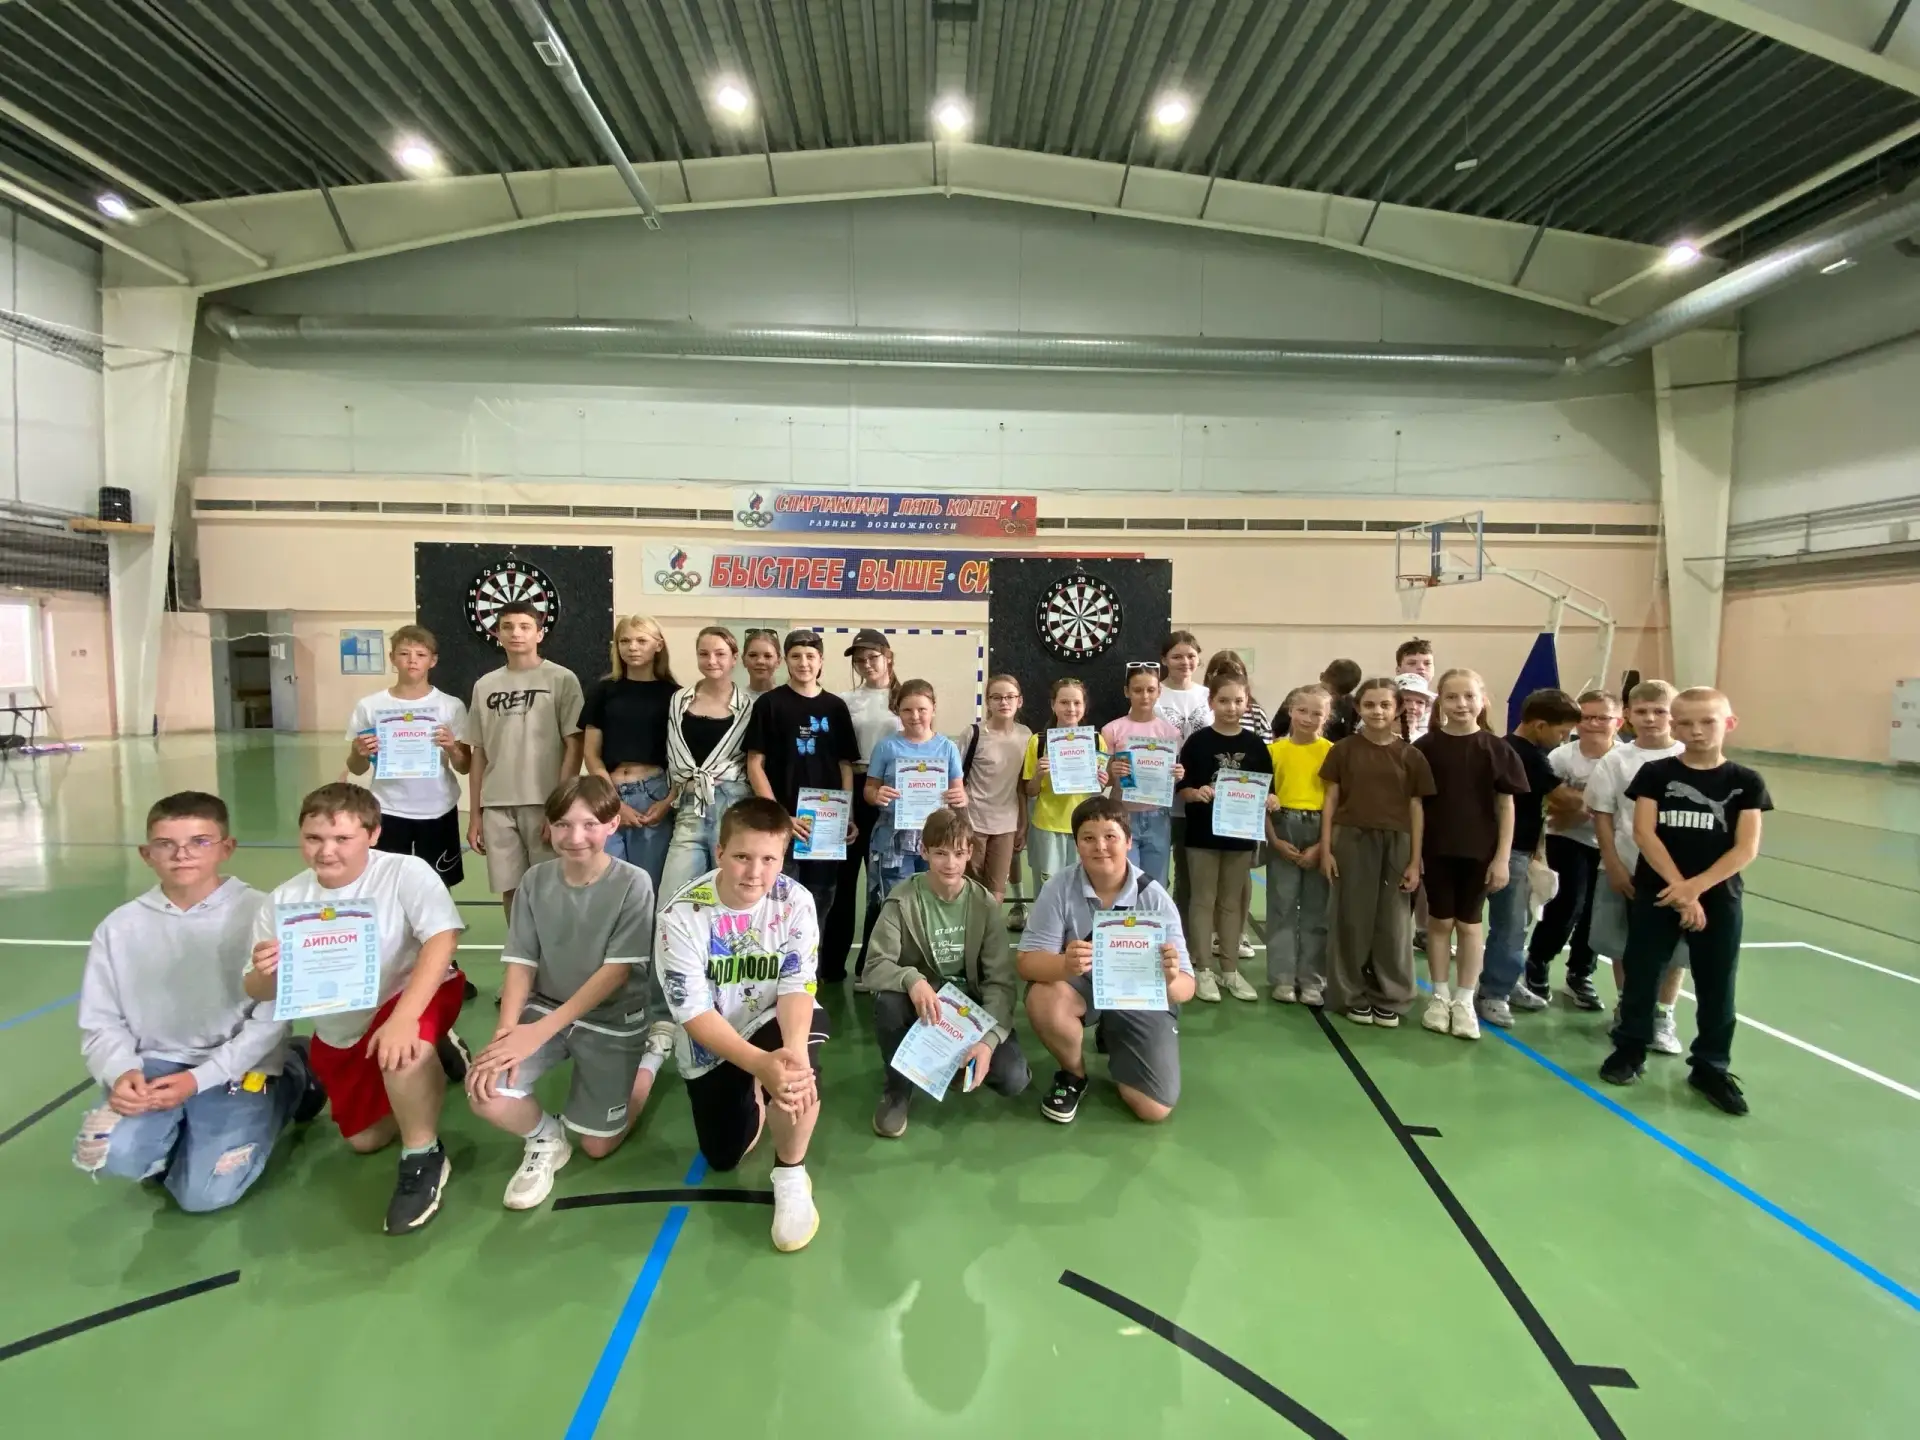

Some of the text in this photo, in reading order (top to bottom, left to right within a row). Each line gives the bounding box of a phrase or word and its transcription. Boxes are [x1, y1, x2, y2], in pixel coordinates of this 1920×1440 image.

[775, 494, 890, 517] СПАРТАКИАДА
[808, 520, 956, 530] РАВНЫЕ ВОЗМОЖНОСТИ
[710, 555, 990, 594] БЫСТРЕЕ ВЫШЕ СИ
[1136, 758, 1164, 766] ДИПЛОМ
[1226, 791, 1256, 800] ДИПЛОМ
[1658, 810, 1714, 830] PUMA
[302, 934, 358, 948] ДИПЛОМ
[1109, 940, 1149, 949] ДИПЛОМ
